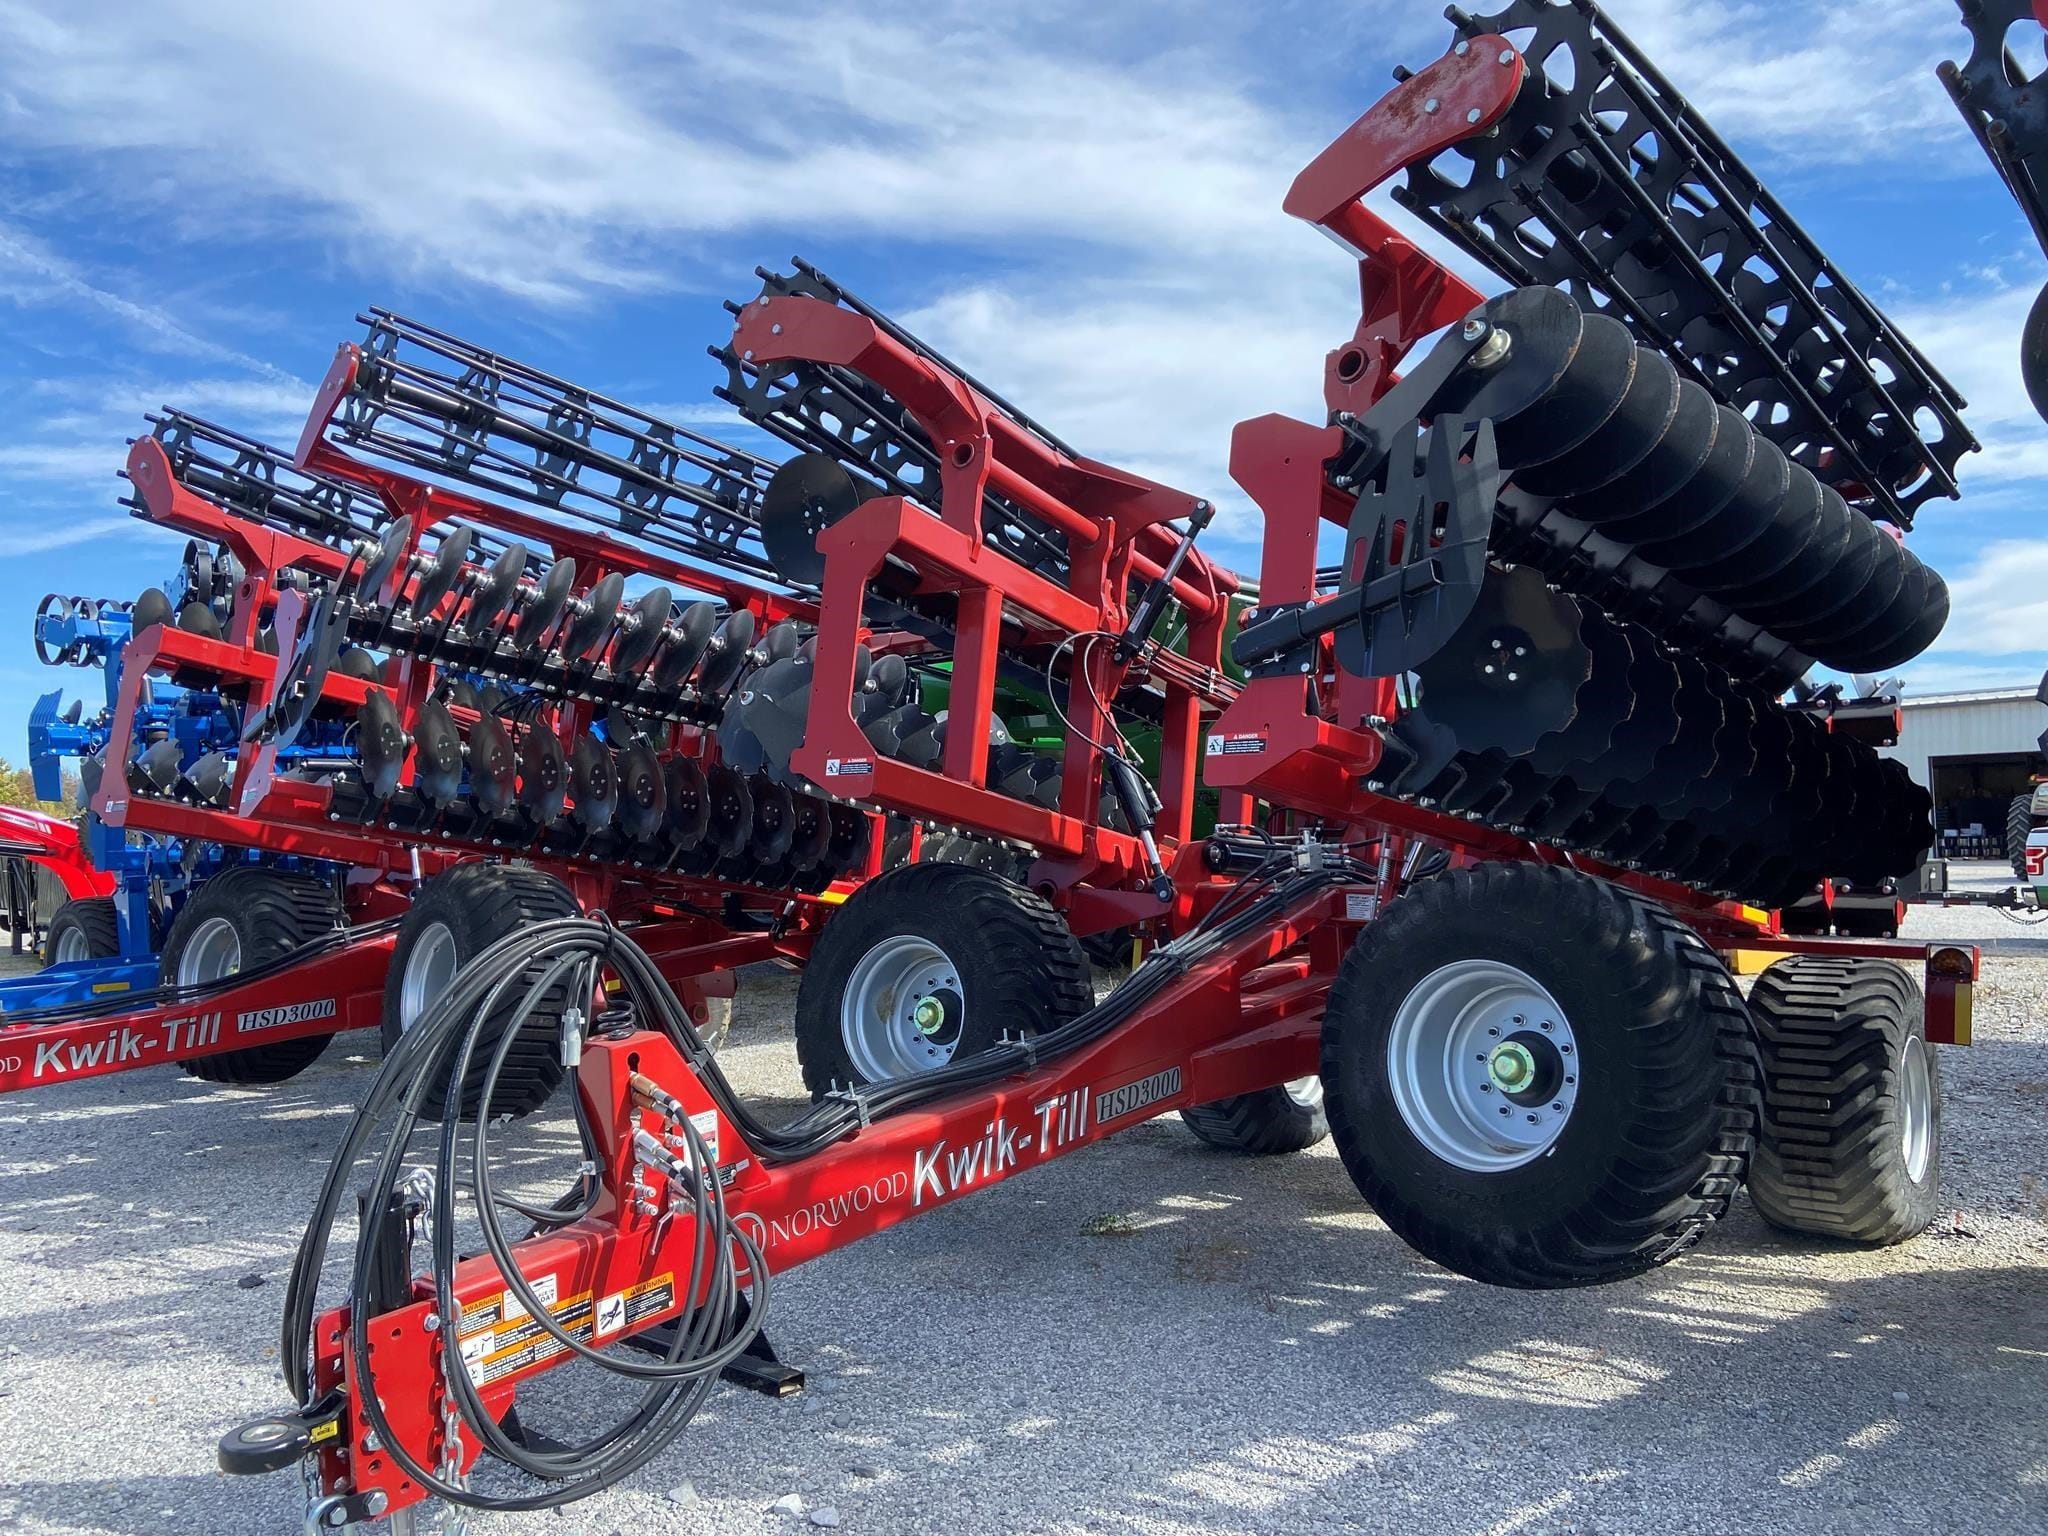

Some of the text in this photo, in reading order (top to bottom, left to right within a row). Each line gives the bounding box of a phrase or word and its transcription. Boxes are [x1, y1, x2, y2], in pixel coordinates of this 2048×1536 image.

[241, 1000, 335, 1032] HSD3000
[33, 1011, 222, 1078] Kwik-Till
[1098, 1067, 1181, 1123] HSD3000
[770, 1086, 1090, 1248] NORWOOD Kwik-Till
[540, 1292, 554, 1302] OAT
[635, 1275, 668, 1293] WARNING
[467, 1295, 500, 1311] WARNING
